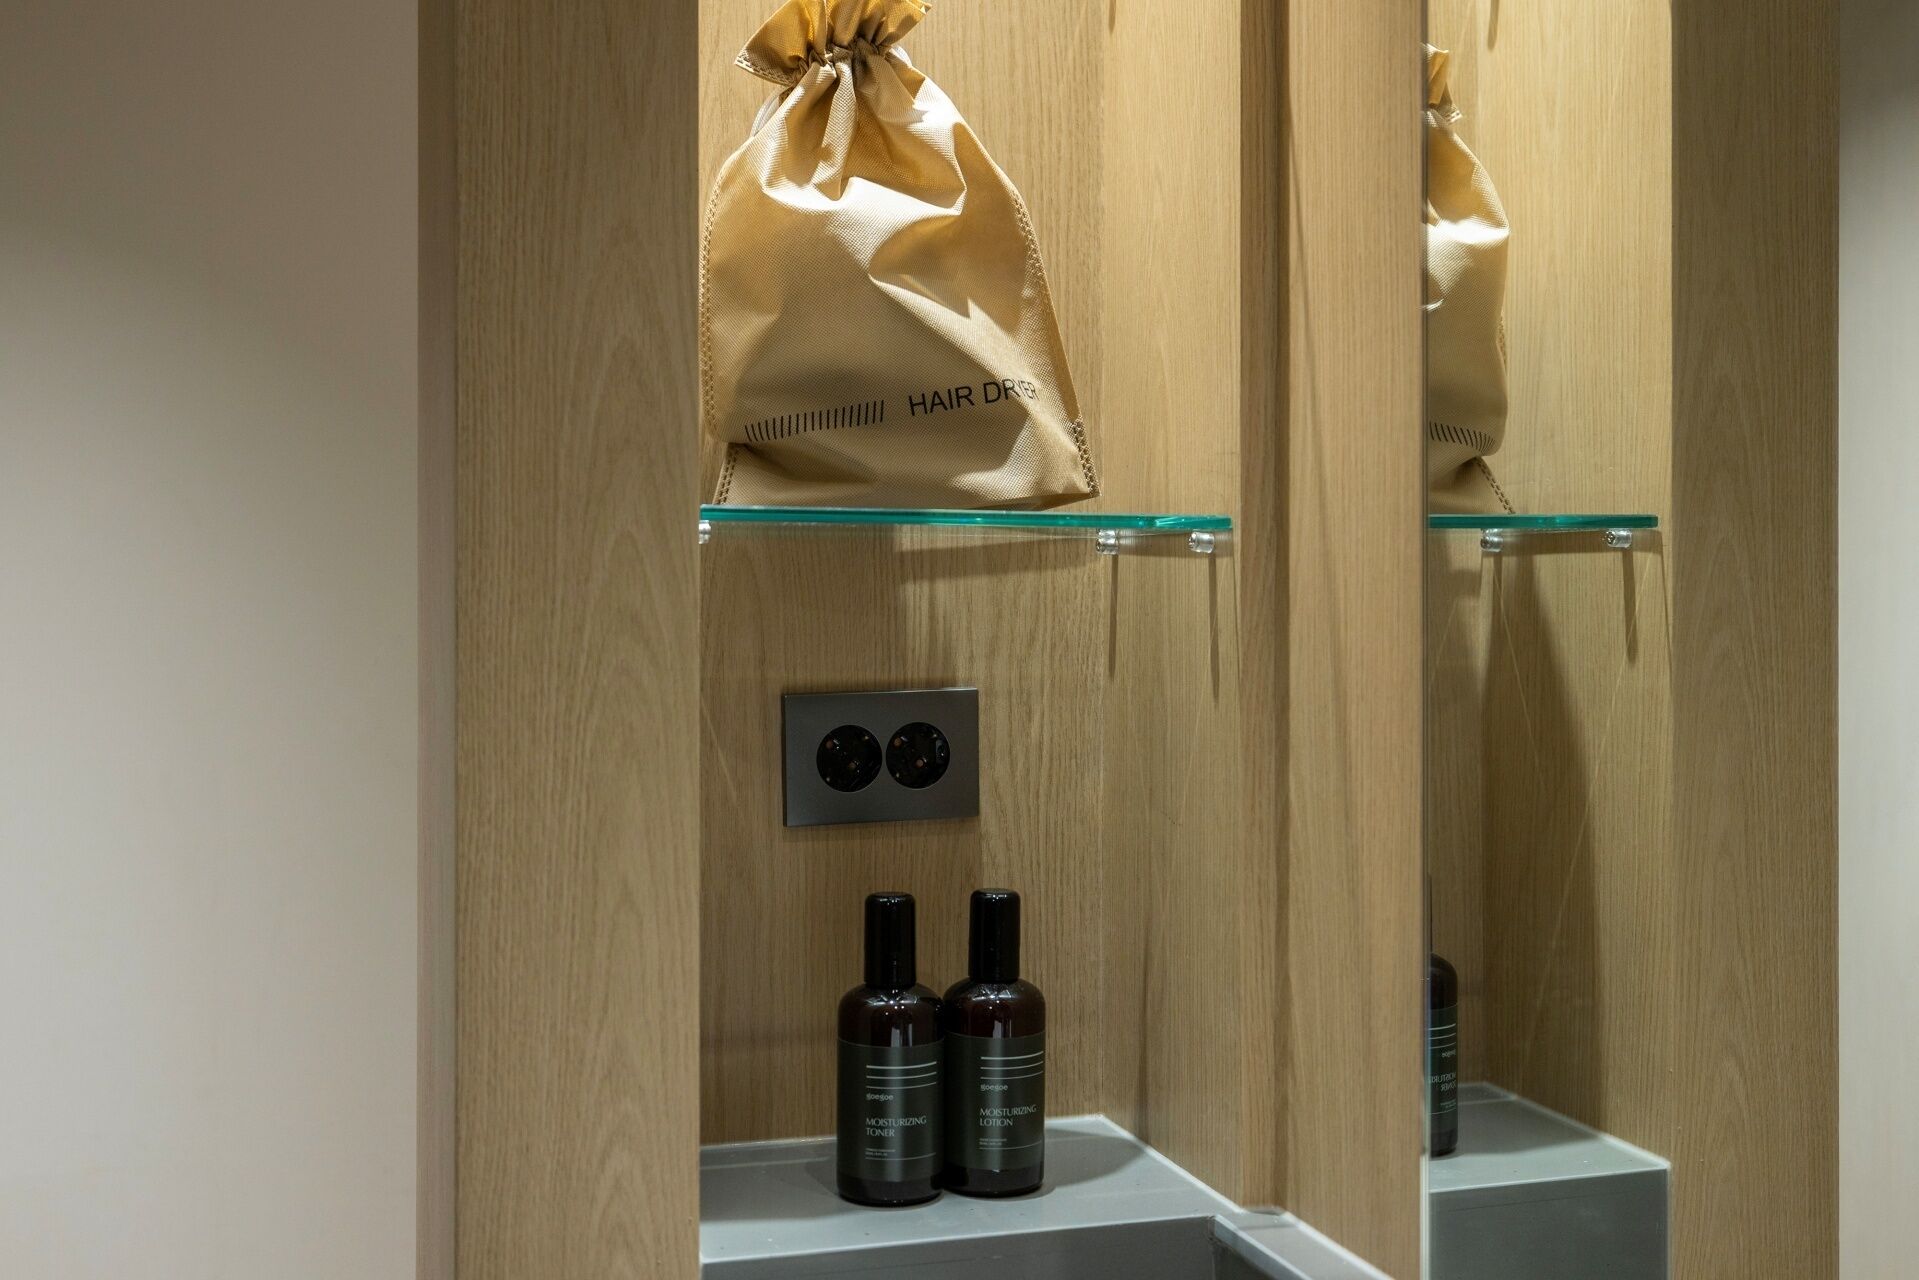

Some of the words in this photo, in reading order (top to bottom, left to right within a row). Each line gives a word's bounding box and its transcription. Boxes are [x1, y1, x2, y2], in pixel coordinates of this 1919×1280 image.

[908, 386, 975, 416] HAIR
[983, 378, 1040, 404] DRYER
[980, 1104, 1037, 1117] MOISTURIZING
[866, 1115, 927, 1127] MOISTURIZING
[980, 1118, 1013, 1127] LOTION
[866, 1127, 896, 1137] TONER
